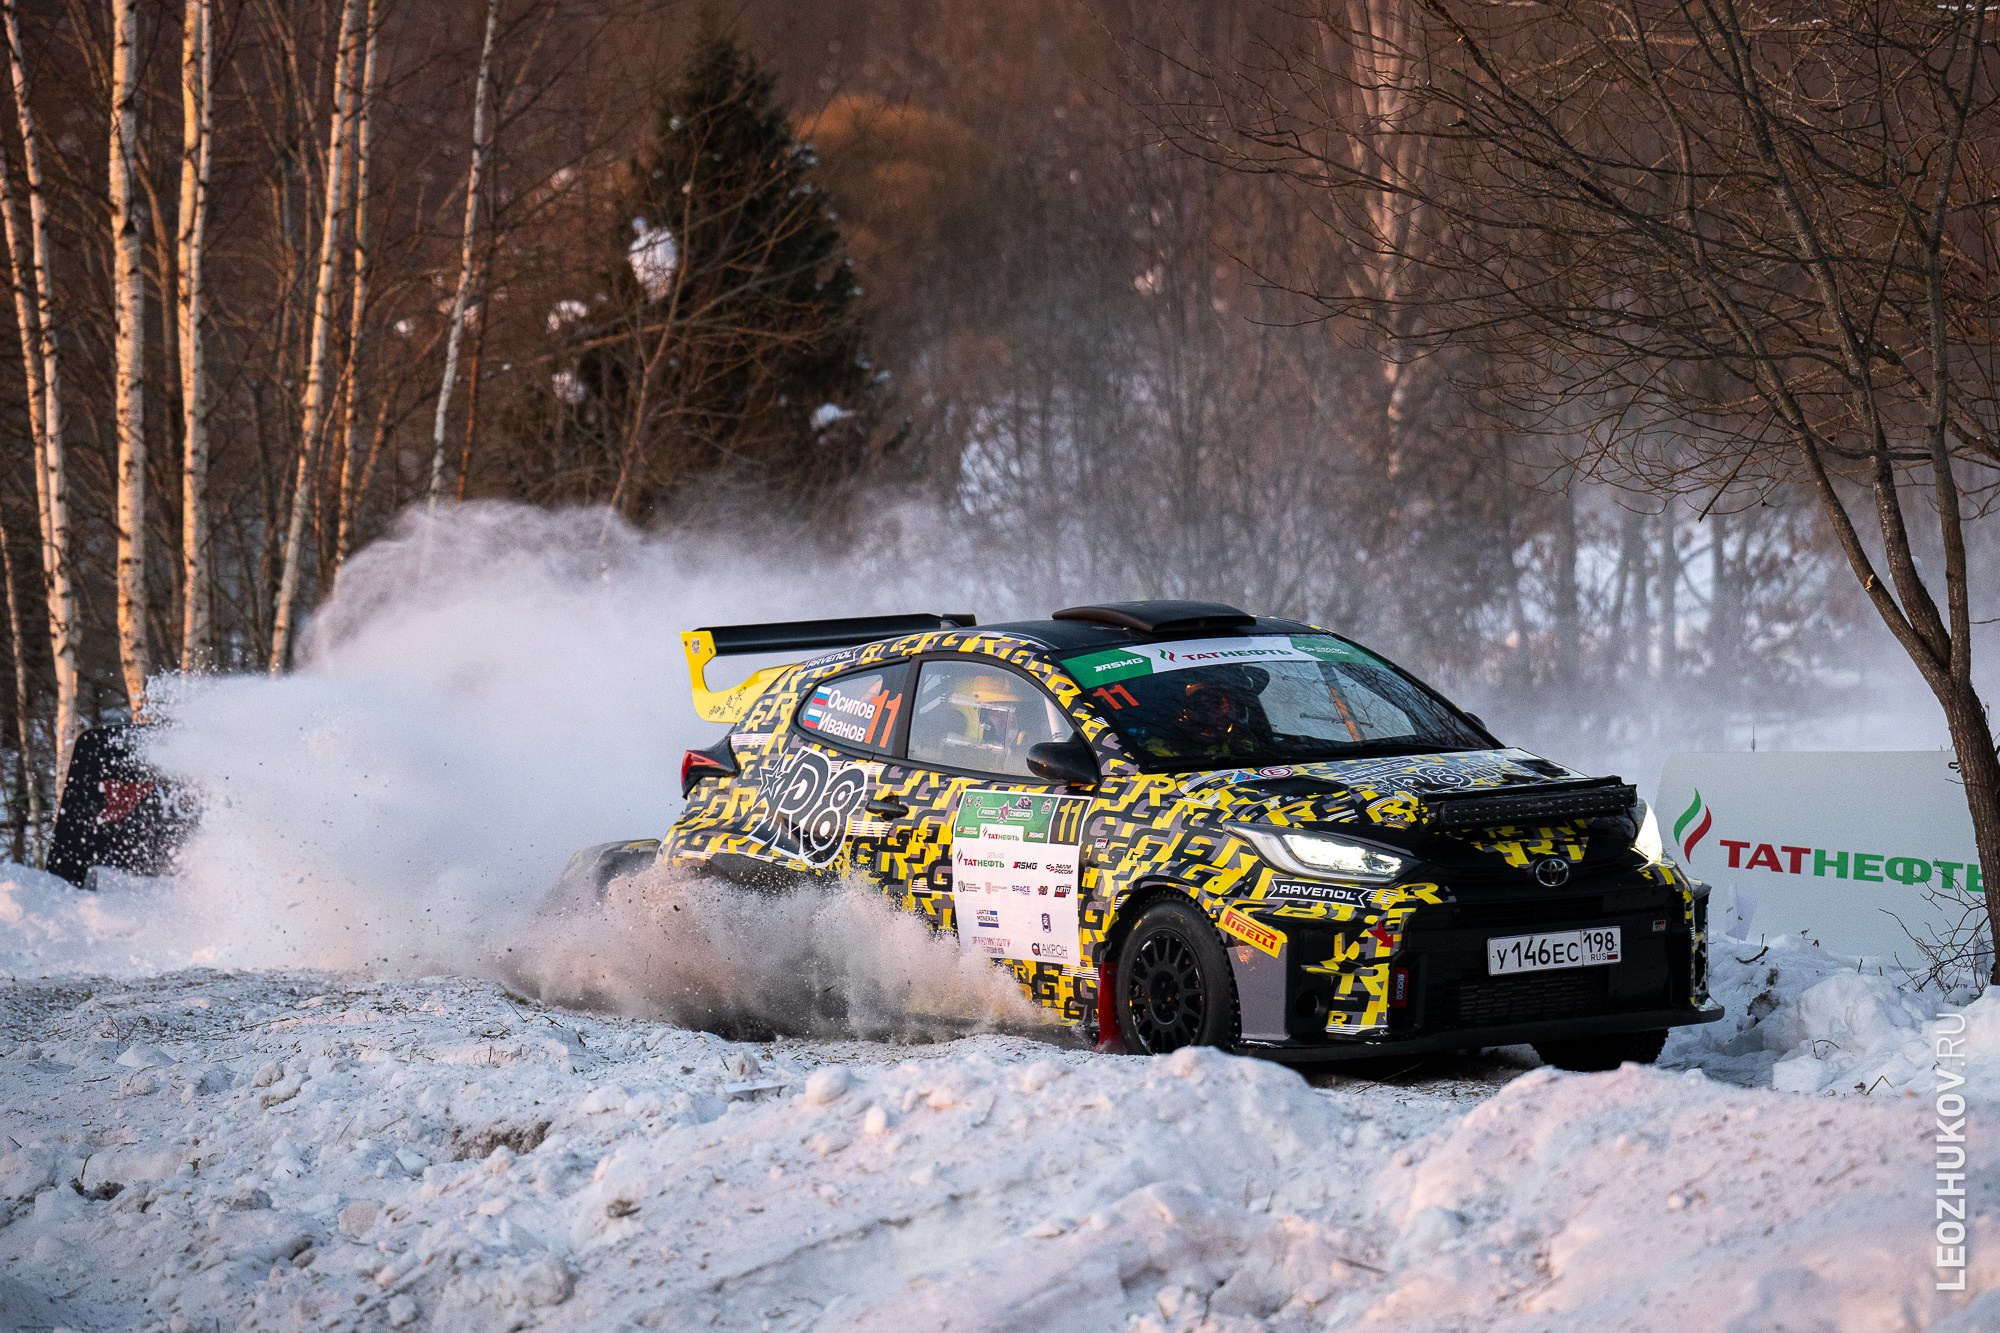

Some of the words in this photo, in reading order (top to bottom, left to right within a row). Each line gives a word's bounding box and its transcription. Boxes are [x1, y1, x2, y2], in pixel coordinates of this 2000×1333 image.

[807, 650, 852, 668] RAVENOL
[1182, 648, 1293, 662] ТАТНЕФТЬ
[827, 689, 876, 720] Осипов
[1092, 684, 1140, 710] 11
[864, 689, 902, 749] 11
[817, 714, 866, 743] Иванов
[1058, 799, 1085, 843] 11
[987, 833, 1020, 841] ТАТНЕФТЬ
[963, 858, 1005, 868] ТАТНЕФТЬ
[1011, 885, 1031, 893] SPACE
[1279, 884, 1354, 901] RAVENOL
[1224, 910, 1277, 950] PIRELLI
[1042, 943, 1068, 956] АКРОН
[1583, 931, 1615, 953] 198
[1590, 952, 1607, 962] RUS
